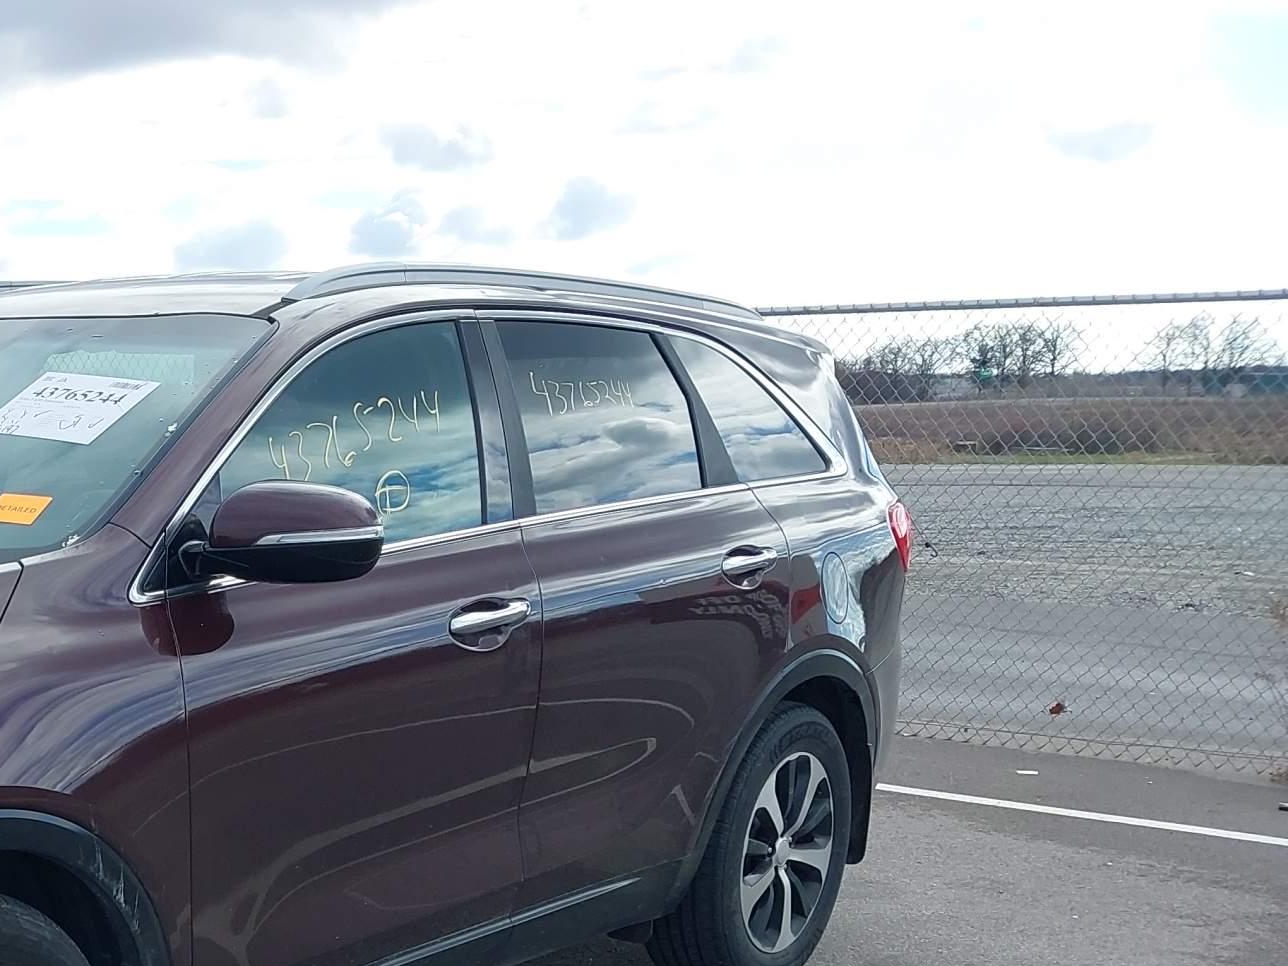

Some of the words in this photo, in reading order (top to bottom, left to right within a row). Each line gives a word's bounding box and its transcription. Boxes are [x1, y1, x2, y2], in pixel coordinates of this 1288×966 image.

[32, 386, 128, 405] 43765244
[529, 371, 634, 416] 43765244
[268, 390, 440, 481] 43765244
